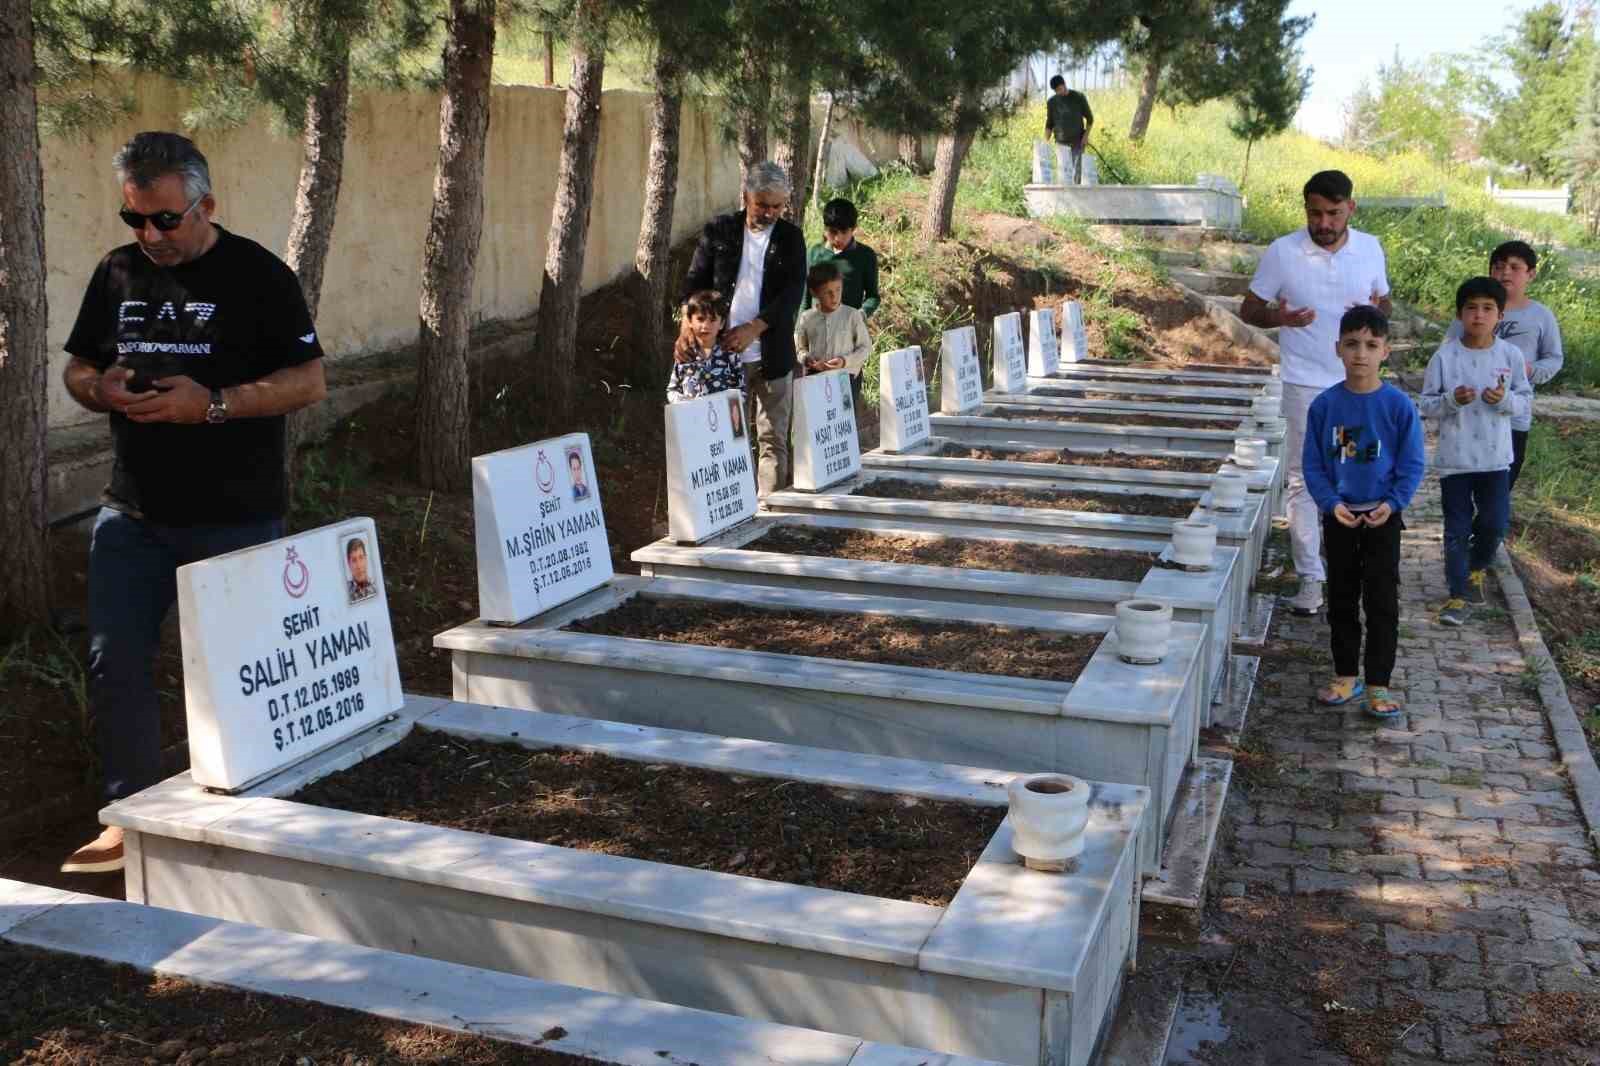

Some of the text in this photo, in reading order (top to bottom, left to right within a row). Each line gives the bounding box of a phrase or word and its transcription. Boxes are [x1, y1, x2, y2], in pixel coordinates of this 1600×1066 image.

[171, 343, 211, 354] ARMANI
[722, 455, 748, 479] YAMAN
[539, 496, 561, 518] ŞEHİT
[506, 508, 601, 559] M.ŞİRİN YAMAN
[283, 605, 320, 640] ŞEHİT
[239, 621, 371, 697] SALİH YAMAN
[268, 666, 360, 721] D.T.12.05.1989
[273, 692, 365, 752] Ş.T.12.05.2016
